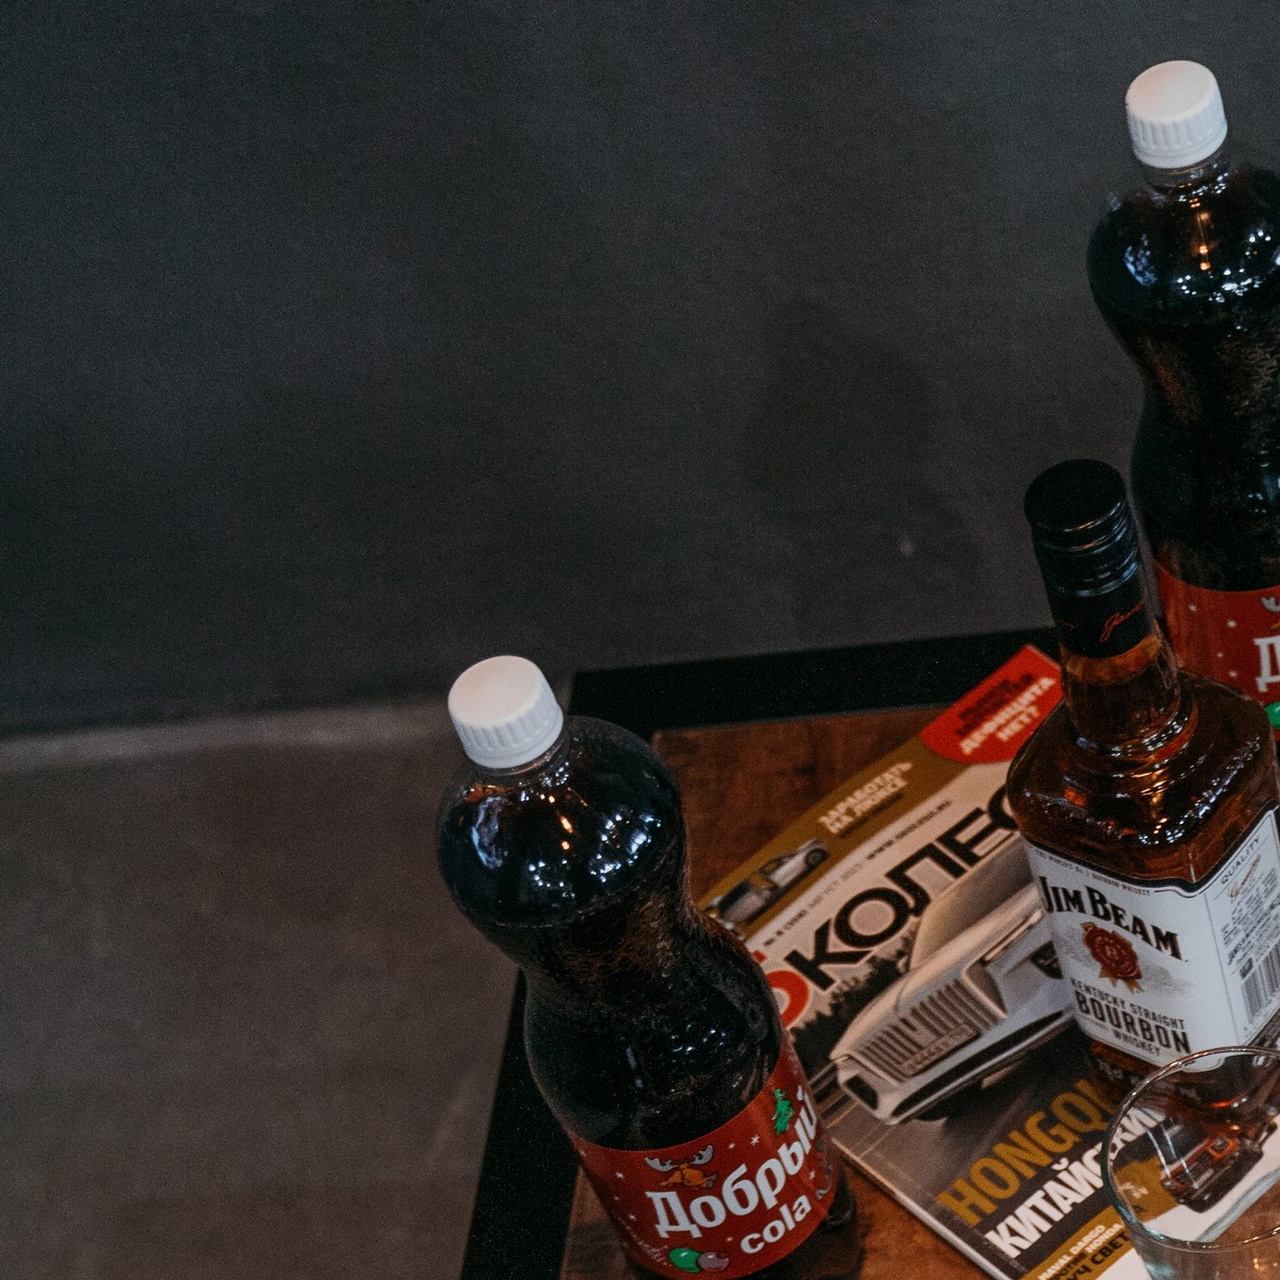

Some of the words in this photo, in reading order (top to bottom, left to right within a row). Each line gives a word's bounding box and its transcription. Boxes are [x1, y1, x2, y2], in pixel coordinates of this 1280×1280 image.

[1220, 837, 1261, 885] QUALITY
[1039, 875, 1087, 914] JIM
[1085, 885, 1184, 962] BEAM
[1070, 976, 1126, 1010] KENTUCKY
[1130, 1002, 1186, 1032] STRAIGHT
[1075, 988, 1192, 1055] BOURBON
[1112, 1030, 1162, 1057] WHISKEY
[646, 1085, 818, 1238] Добрый
[741, 1195, 812, 1254] cola
[1070, 1225, 1106, 1255] DARGO
